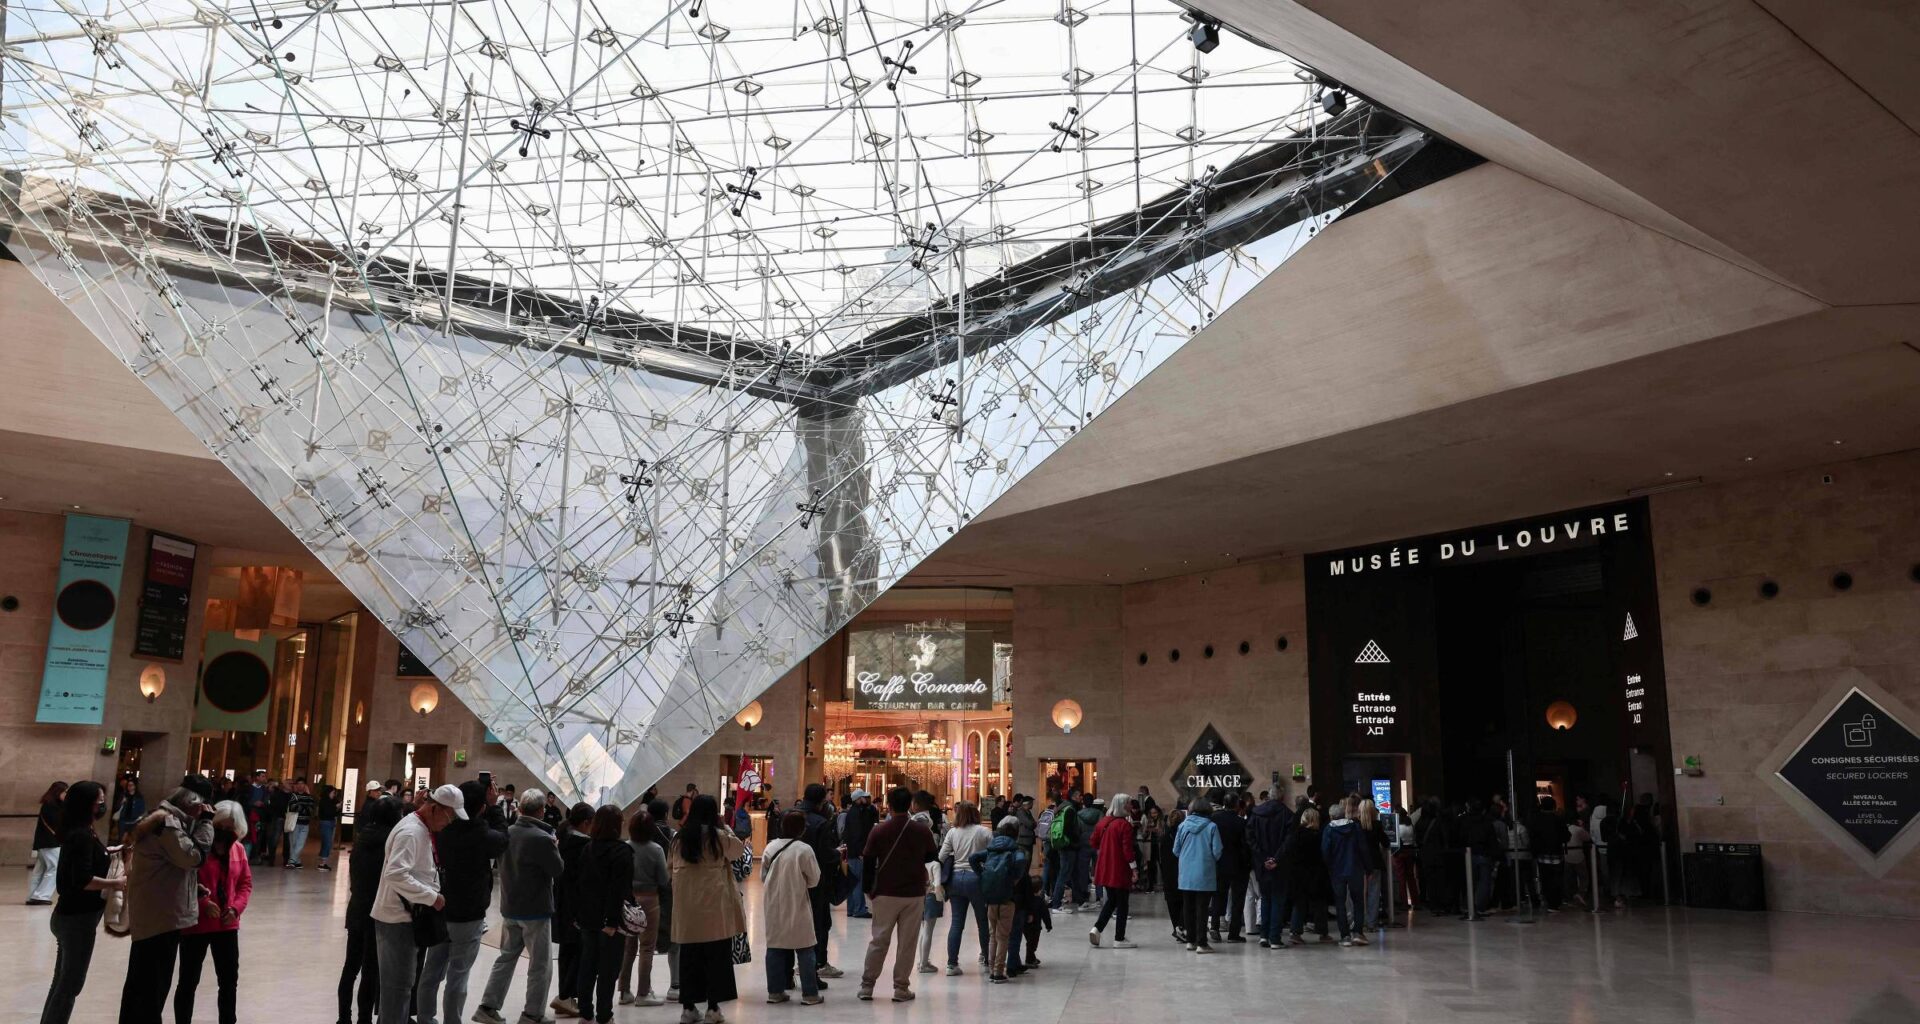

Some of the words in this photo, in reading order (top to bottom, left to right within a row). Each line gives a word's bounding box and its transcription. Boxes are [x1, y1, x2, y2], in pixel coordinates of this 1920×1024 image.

[1329, 547, 1420, 576] MUSÉE
[1440, 539, 1476, 560] DU
[1497, 513, 1629, 551] LOUVRE
[911, 671, 989, 696] Concerto
[1626, 673, 1641, 685] Entrée
[1358, 692, 1391, 702] Entrée
[1625, 687, 1645, 699] Entrance
[1352, 703, 1397, 713] Entrance
[1355, 715, 1395, 724] Entrada
[1633, 713, 1641, 724] 入口
[1366, 726, 1384, 736] 入口
[1196, 753, 1230, 765] 货币兑换
[1863, 754, 1920, 764] SÉCURISÉES
[1187, 775, 1241, 787] CHANGE
[1826, 772, 1866, 780] SECURED
